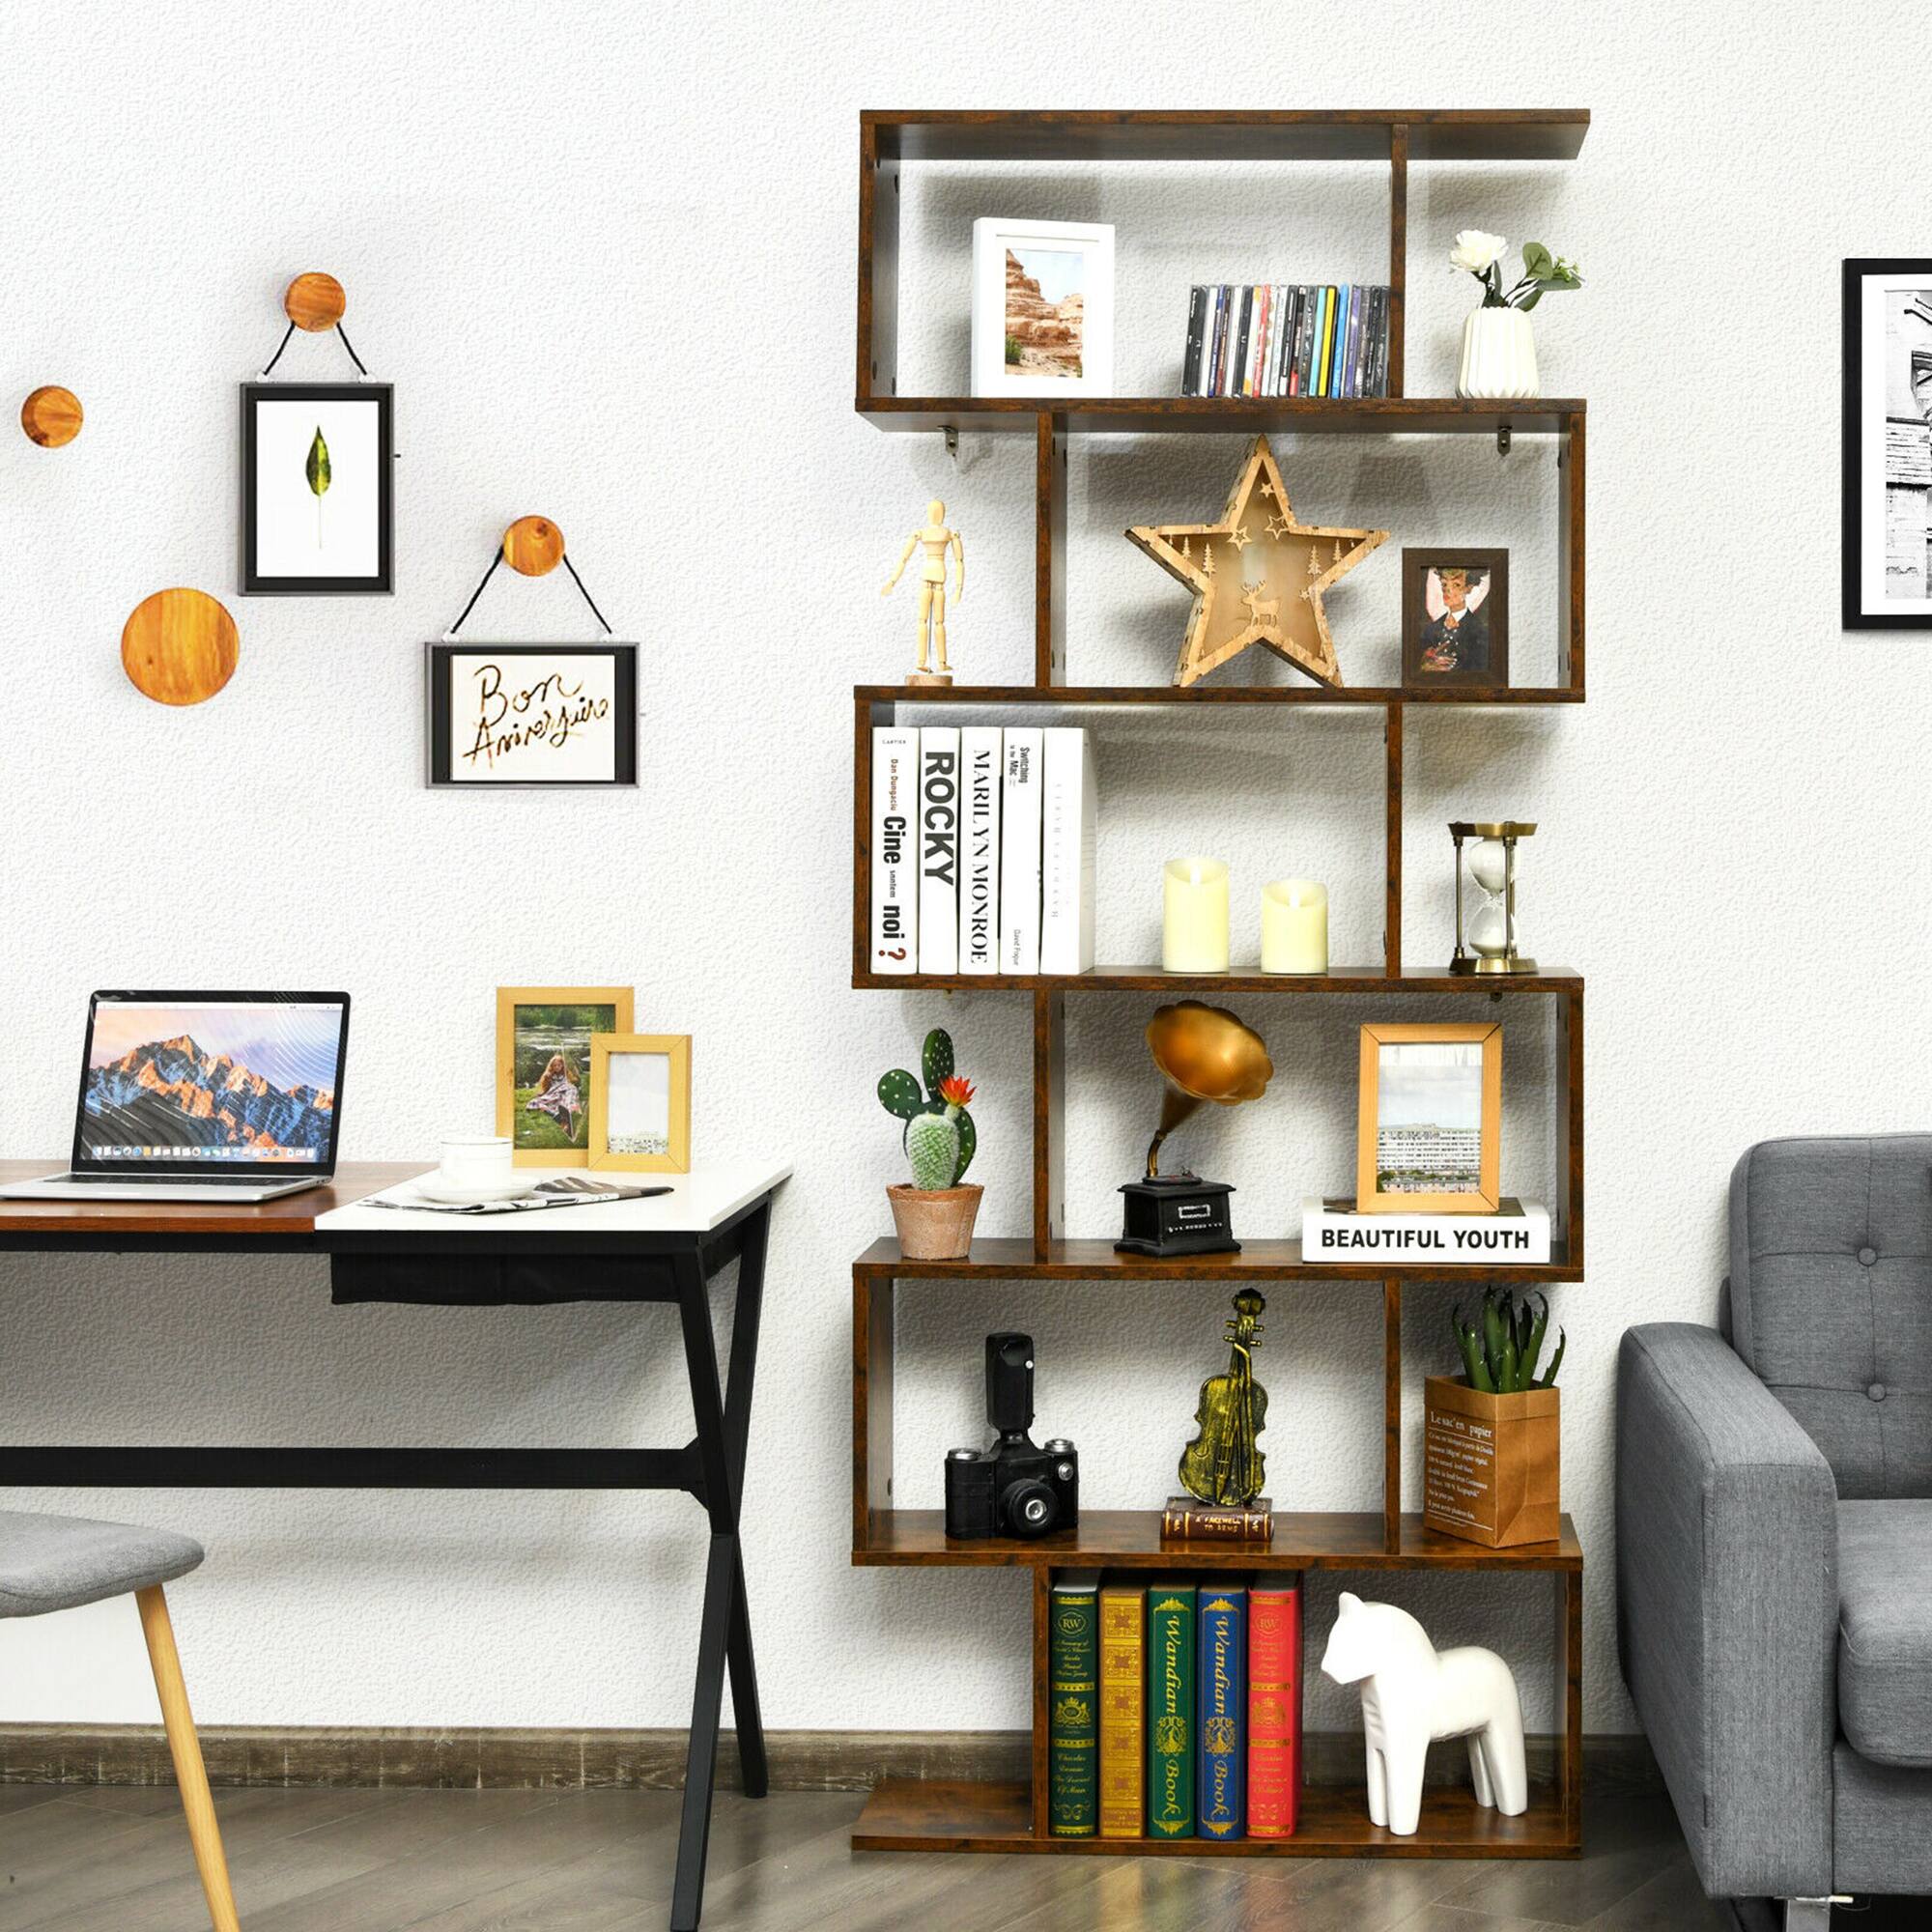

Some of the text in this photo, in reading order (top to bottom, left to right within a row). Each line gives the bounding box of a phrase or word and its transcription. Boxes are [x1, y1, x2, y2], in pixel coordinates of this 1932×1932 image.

[473, 664, 583, 726] Bon
[890, 758, 899, 774] Dan
[1008, 759, 1019, 777] Mac
[1018, 746, 1031, 784] Switching
[883, 815, 907, 865] Cine
[923, 752, 955, 887] ROCKY
[970, 750, 991, 964] MARILYN MONROE
[882, 904, 906, 939] noi
[1321, 1229, 1529, 1249] BEAUTIFUL YOUTH
[1063, 1618, 1081, 1629] RW
[1163, 1615, 1182, 1819] Wandian Book
[1211, 1616, 1231, 1820] Wandian Book
